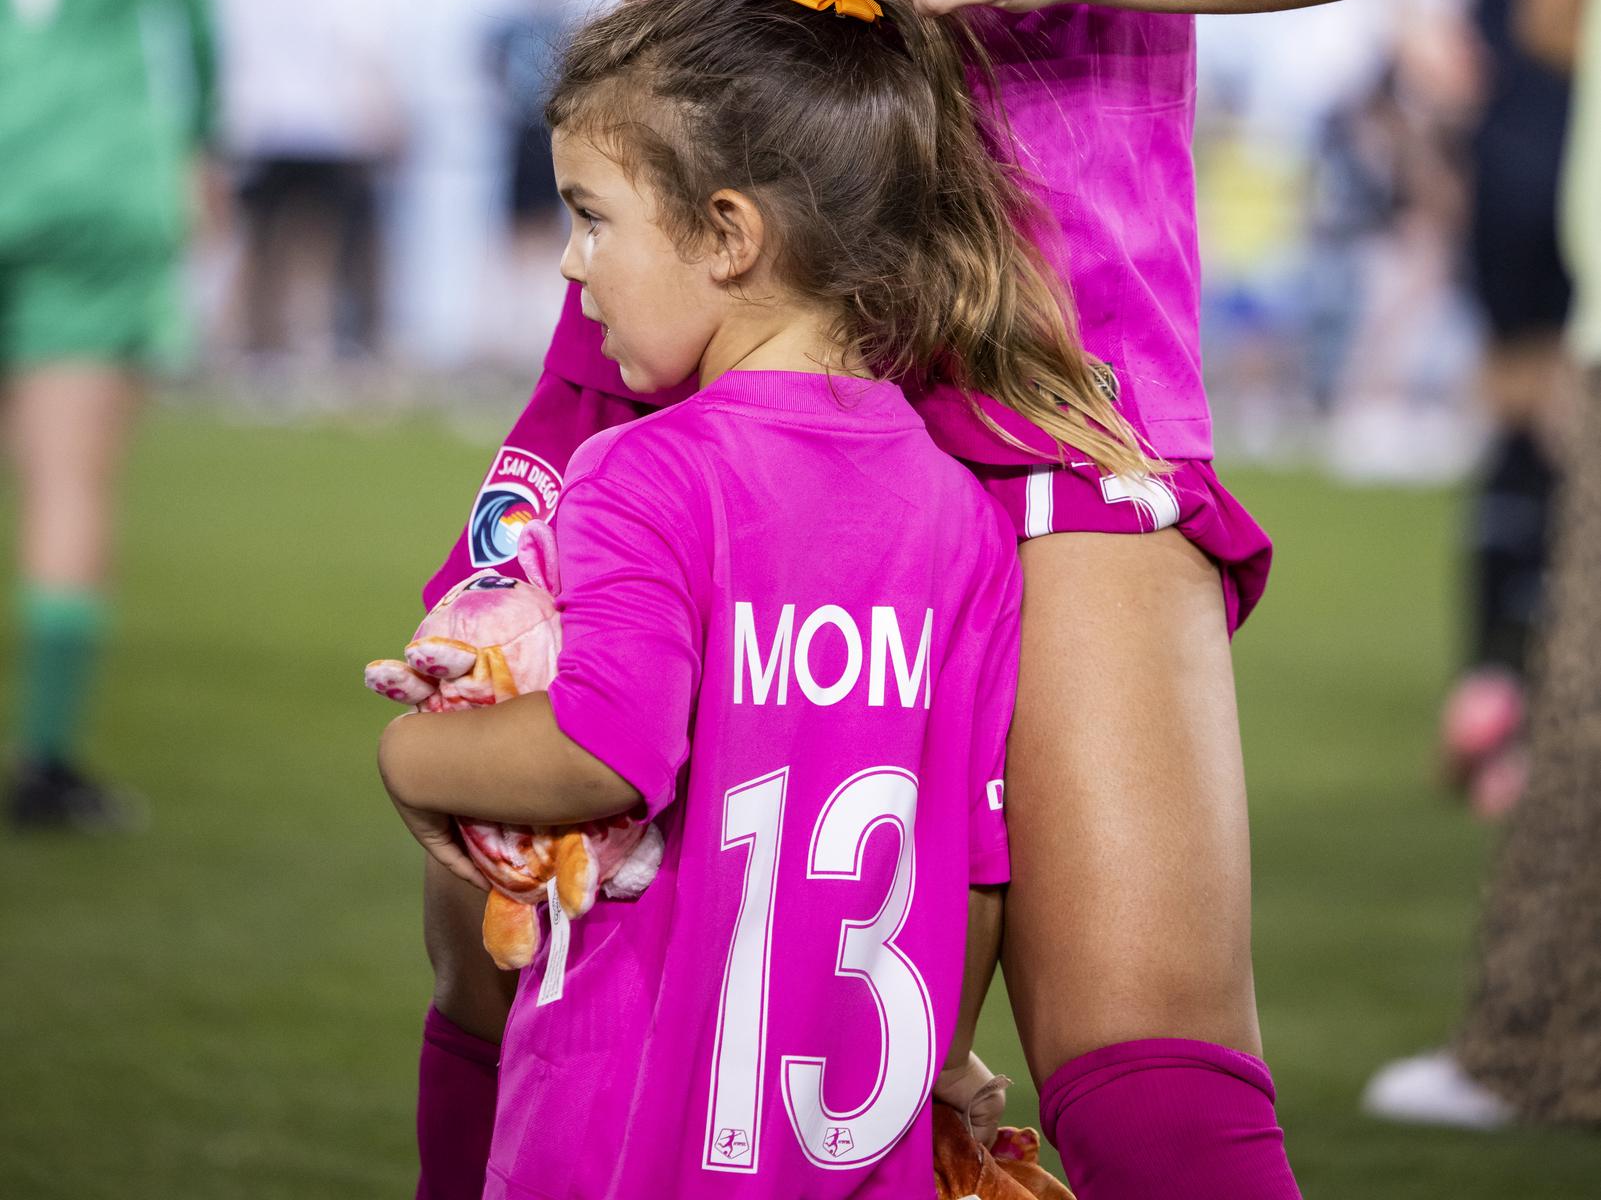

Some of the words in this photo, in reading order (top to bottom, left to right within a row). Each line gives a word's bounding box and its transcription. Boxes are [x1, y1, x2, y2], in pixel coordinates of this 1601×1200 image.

[498, 456, 530, 478] SAN
[527, 465, 559, 509] DIEGO
[733, 601, 934, 710] MOM
[702, 765, 936, 1174] 13
